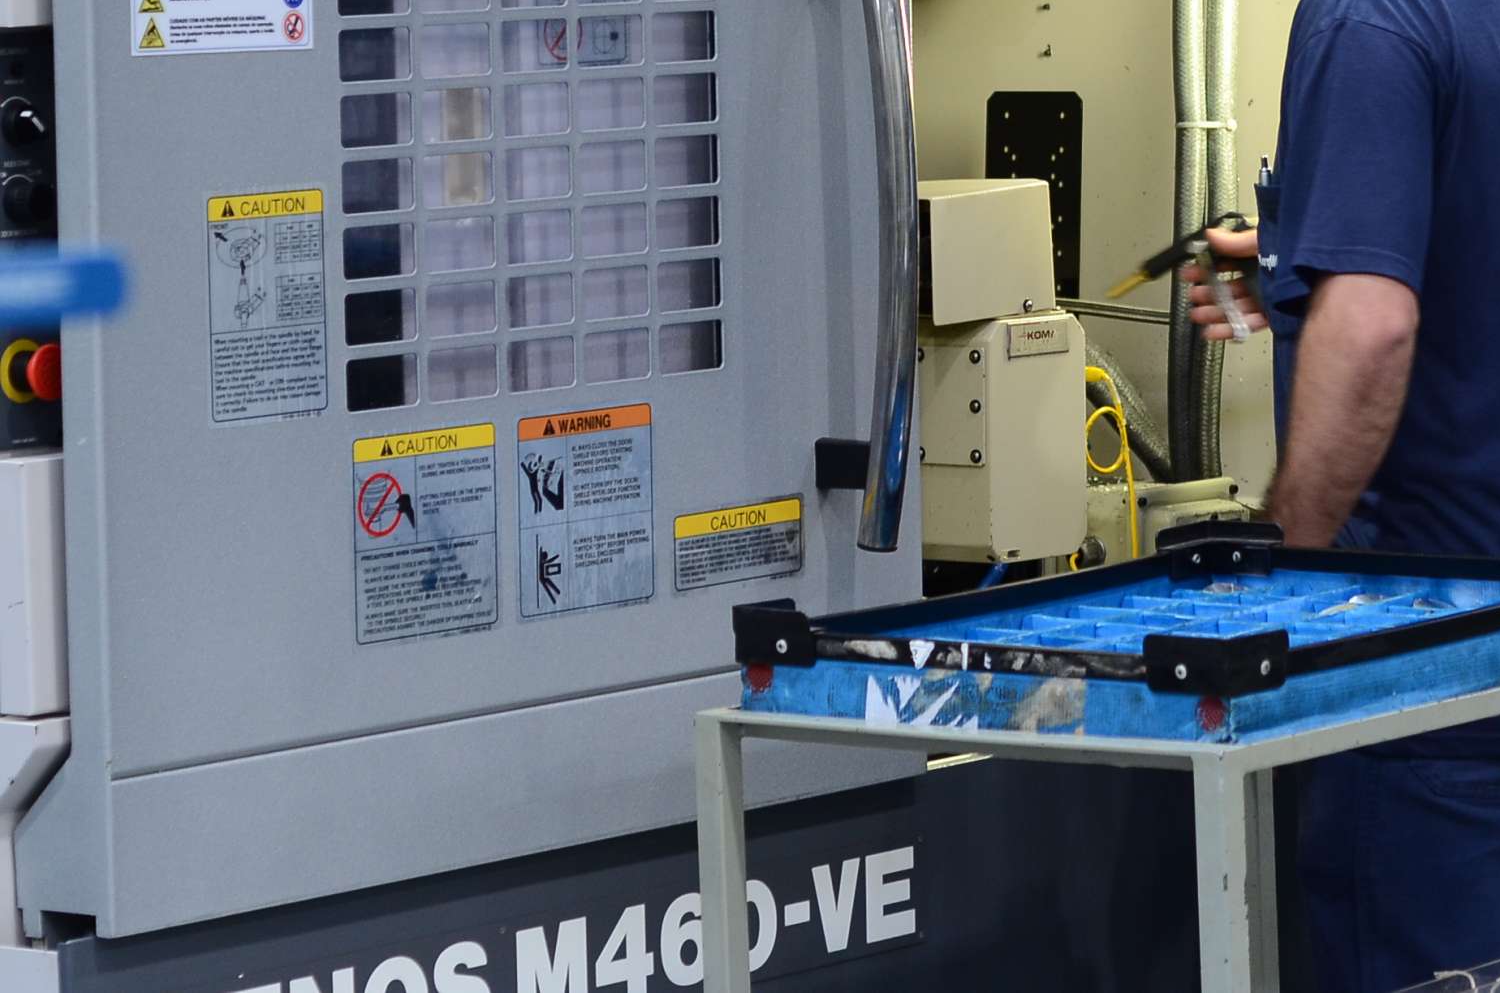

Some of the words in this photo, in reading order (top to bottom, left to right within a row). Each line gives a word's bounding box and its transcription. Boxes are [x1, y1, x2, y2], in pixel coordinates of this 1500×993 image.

[240, 198, 306, 217] CAUTION
[558, 414, 612, 434] WARNING
[396, 434, 458, 456] CAUTION
[710, 510, 767, 531] CAUTION
[516, 846, 916, 993] M460-VE
